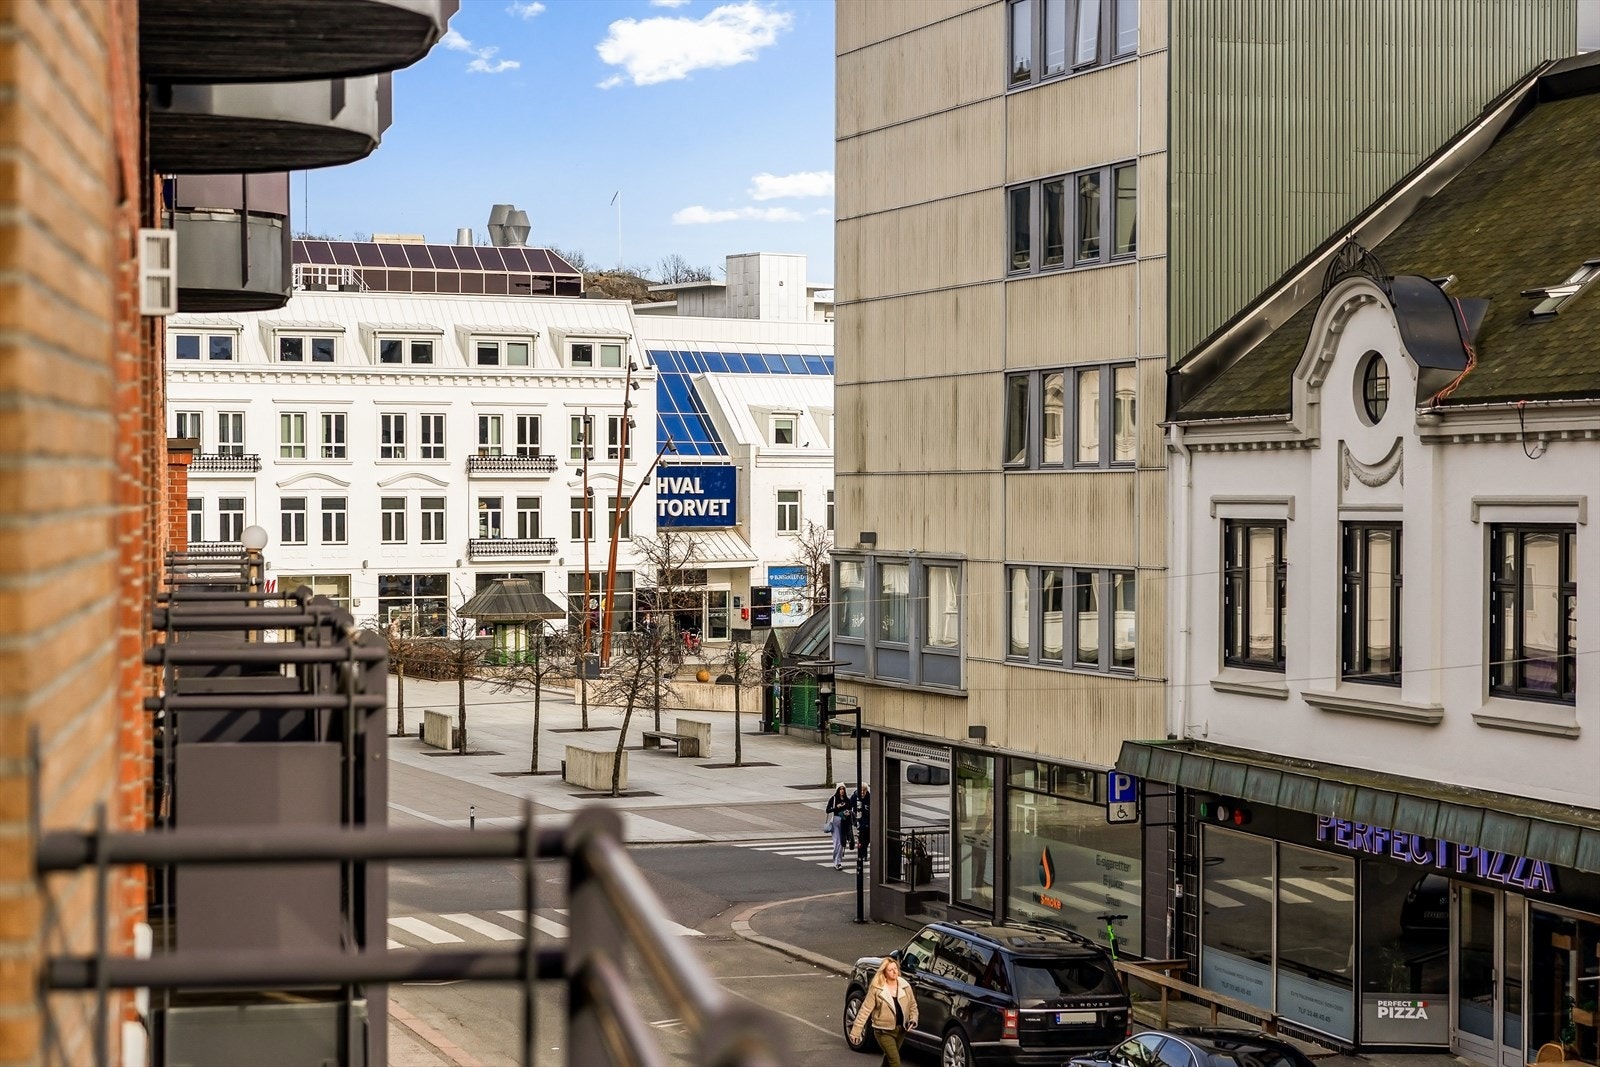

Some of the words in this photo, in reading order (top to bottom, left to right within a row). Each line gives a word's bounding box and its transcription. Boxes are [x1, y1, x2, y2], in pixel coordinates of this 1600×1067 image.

[657, 477, 704, 494] HVAL
[657, 499, 731, 517] TORVET
[1114, 774, 1132, 800] P
[1455, 843, 1557, 893] PIZZA
[1377, 1006, 1429, 1019] PIZZA
